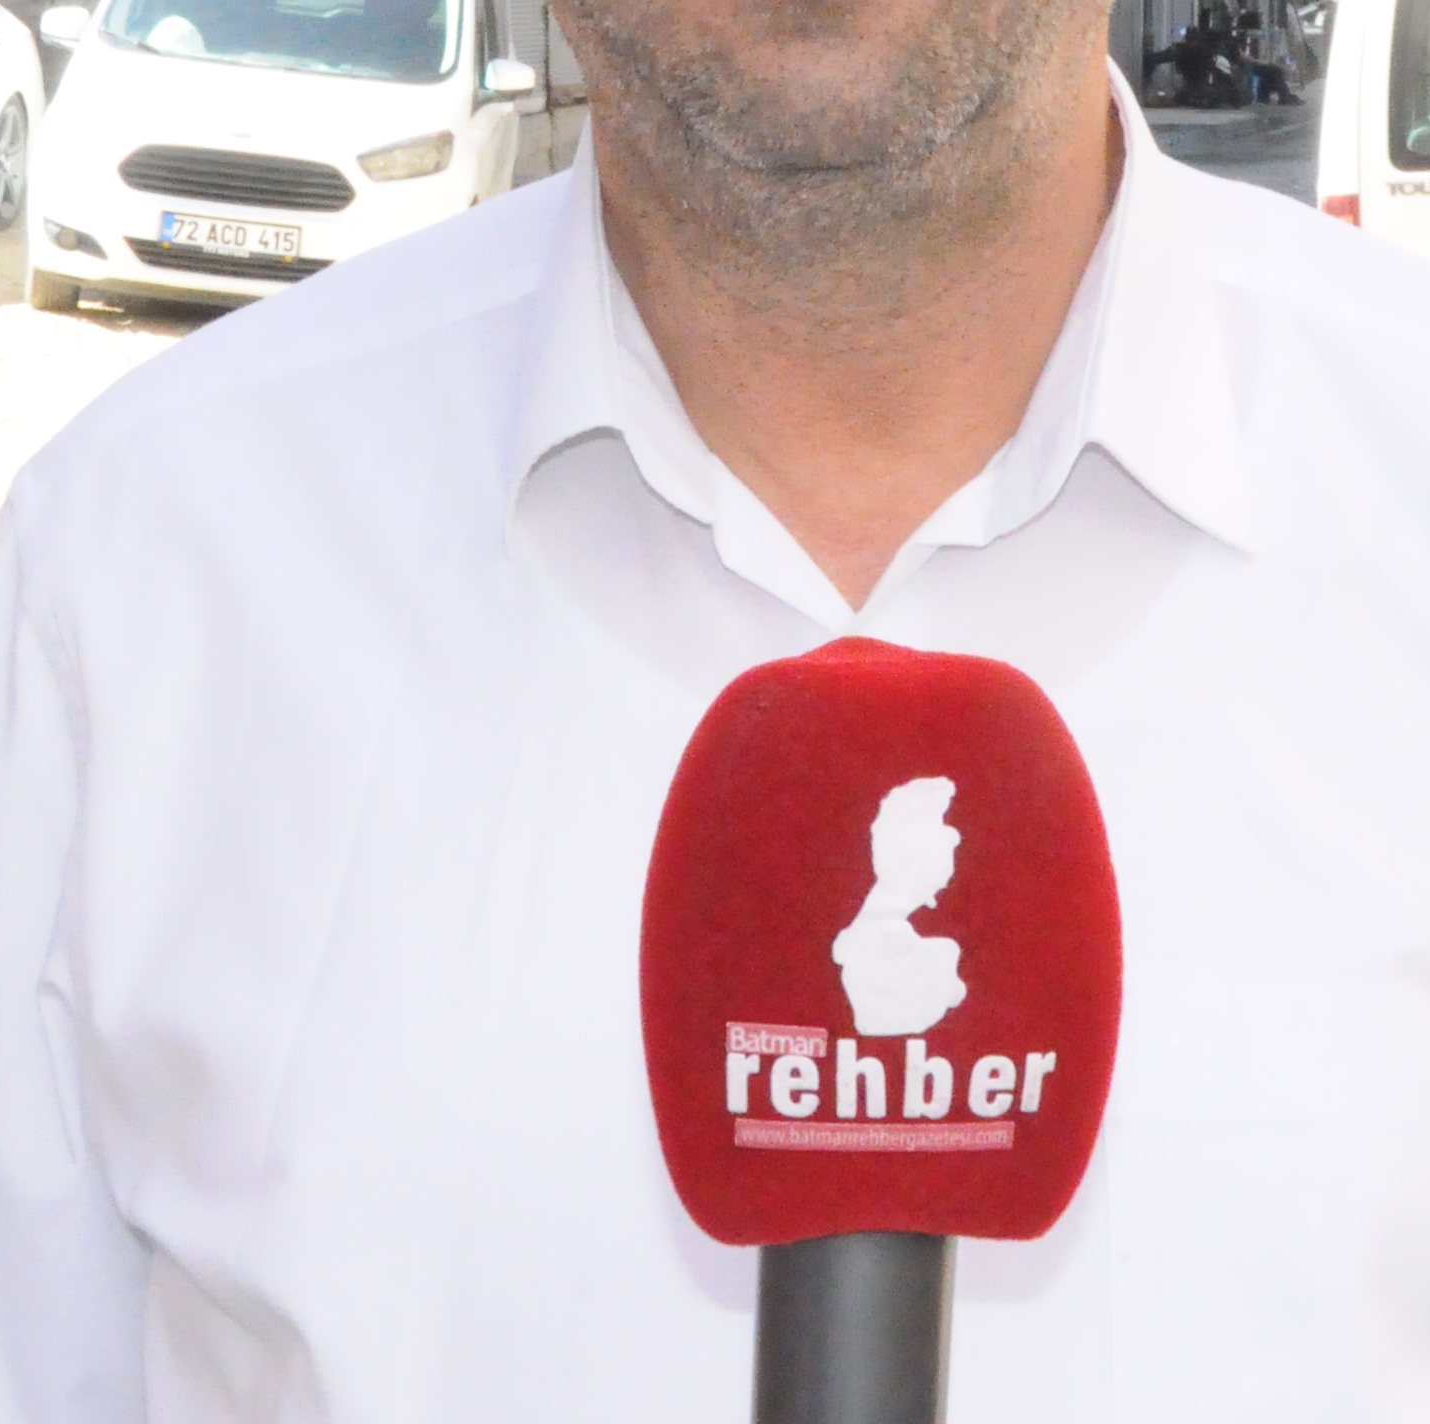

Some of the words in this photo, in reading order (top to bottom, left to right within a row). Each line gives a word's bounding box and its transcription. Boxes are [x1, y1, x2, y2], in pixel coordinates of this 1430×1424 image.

[173, 220, 197, 242] 72
[207, 223, 247, 246] ACD
[259, 230, 295, 252] 415
[729, 1026, 825, 1056] Batman
[726, 1038, 1057, 1120] rehber
